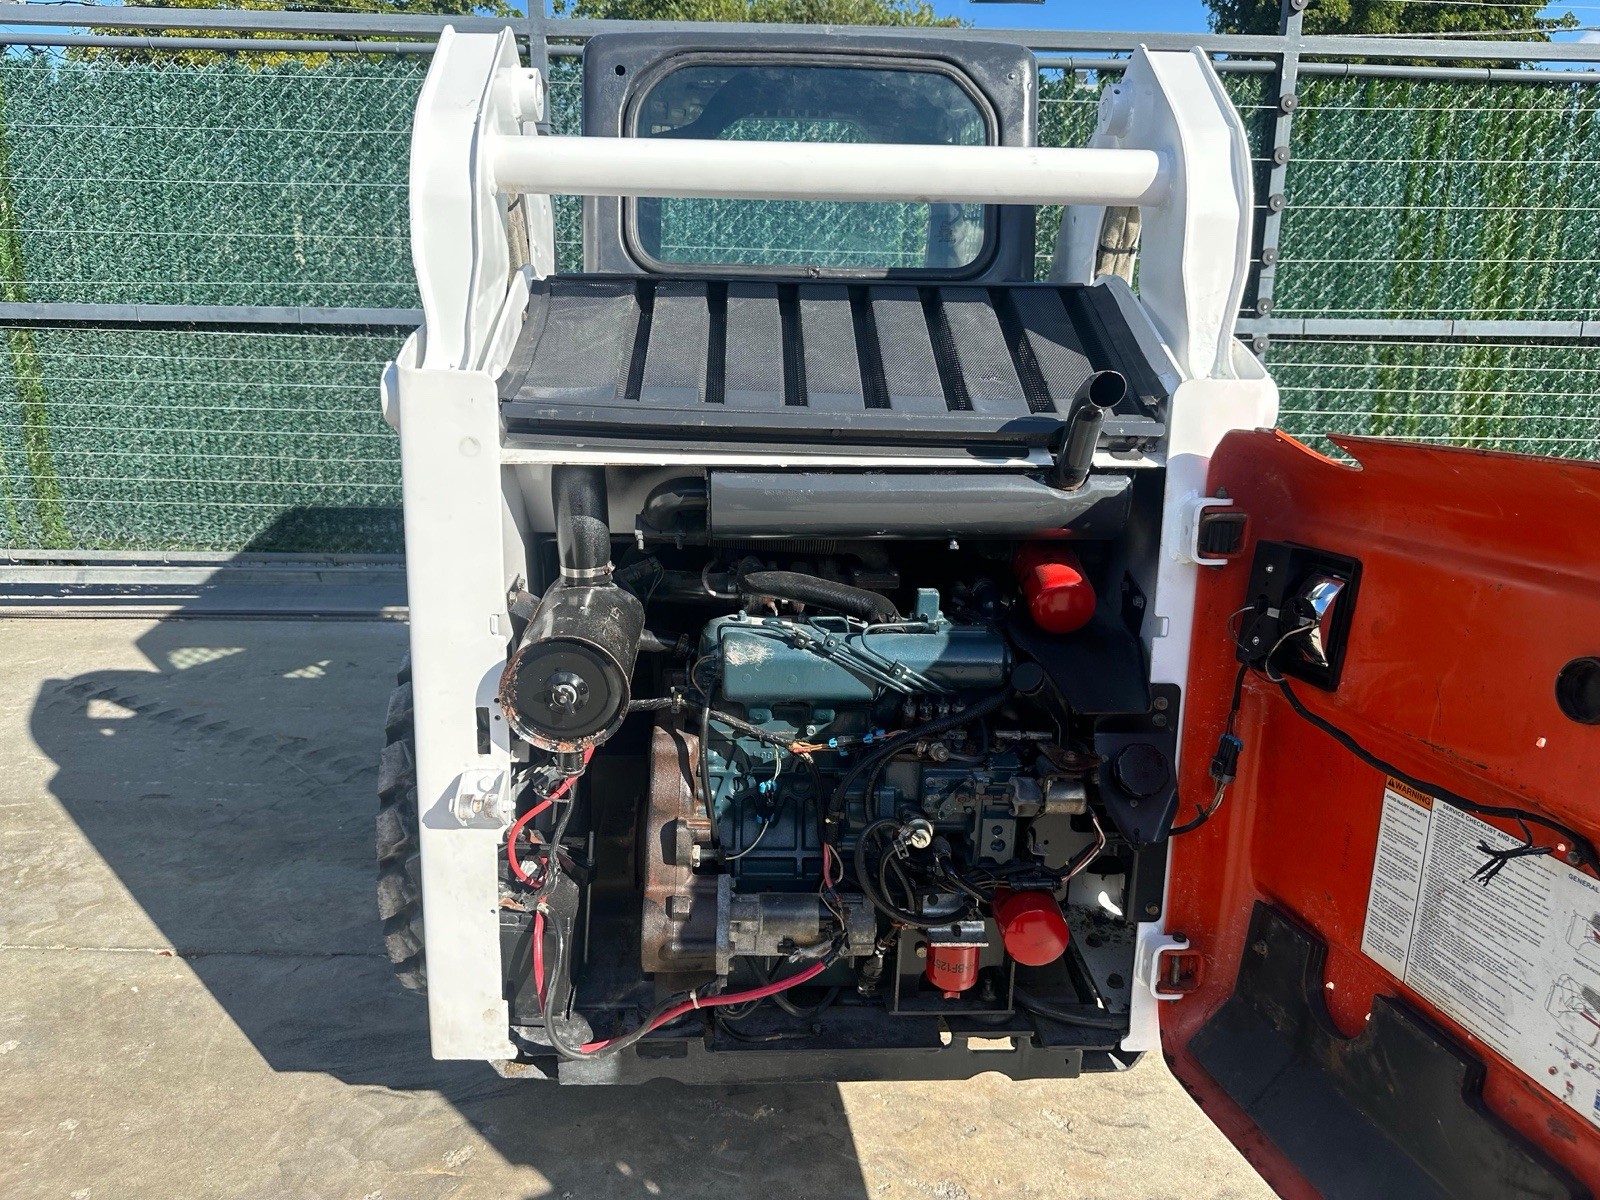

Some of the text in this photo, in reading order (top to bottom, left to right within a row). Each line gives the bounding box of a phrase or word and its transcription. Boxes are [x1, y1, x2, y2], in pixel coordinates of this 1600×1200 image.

[1395, 782, 1431, 806] WARNING
[1442, 803, 1510, 842] SERVICE CHECKLIST AND
[1568, 873, 1600, 894] GENERAL
